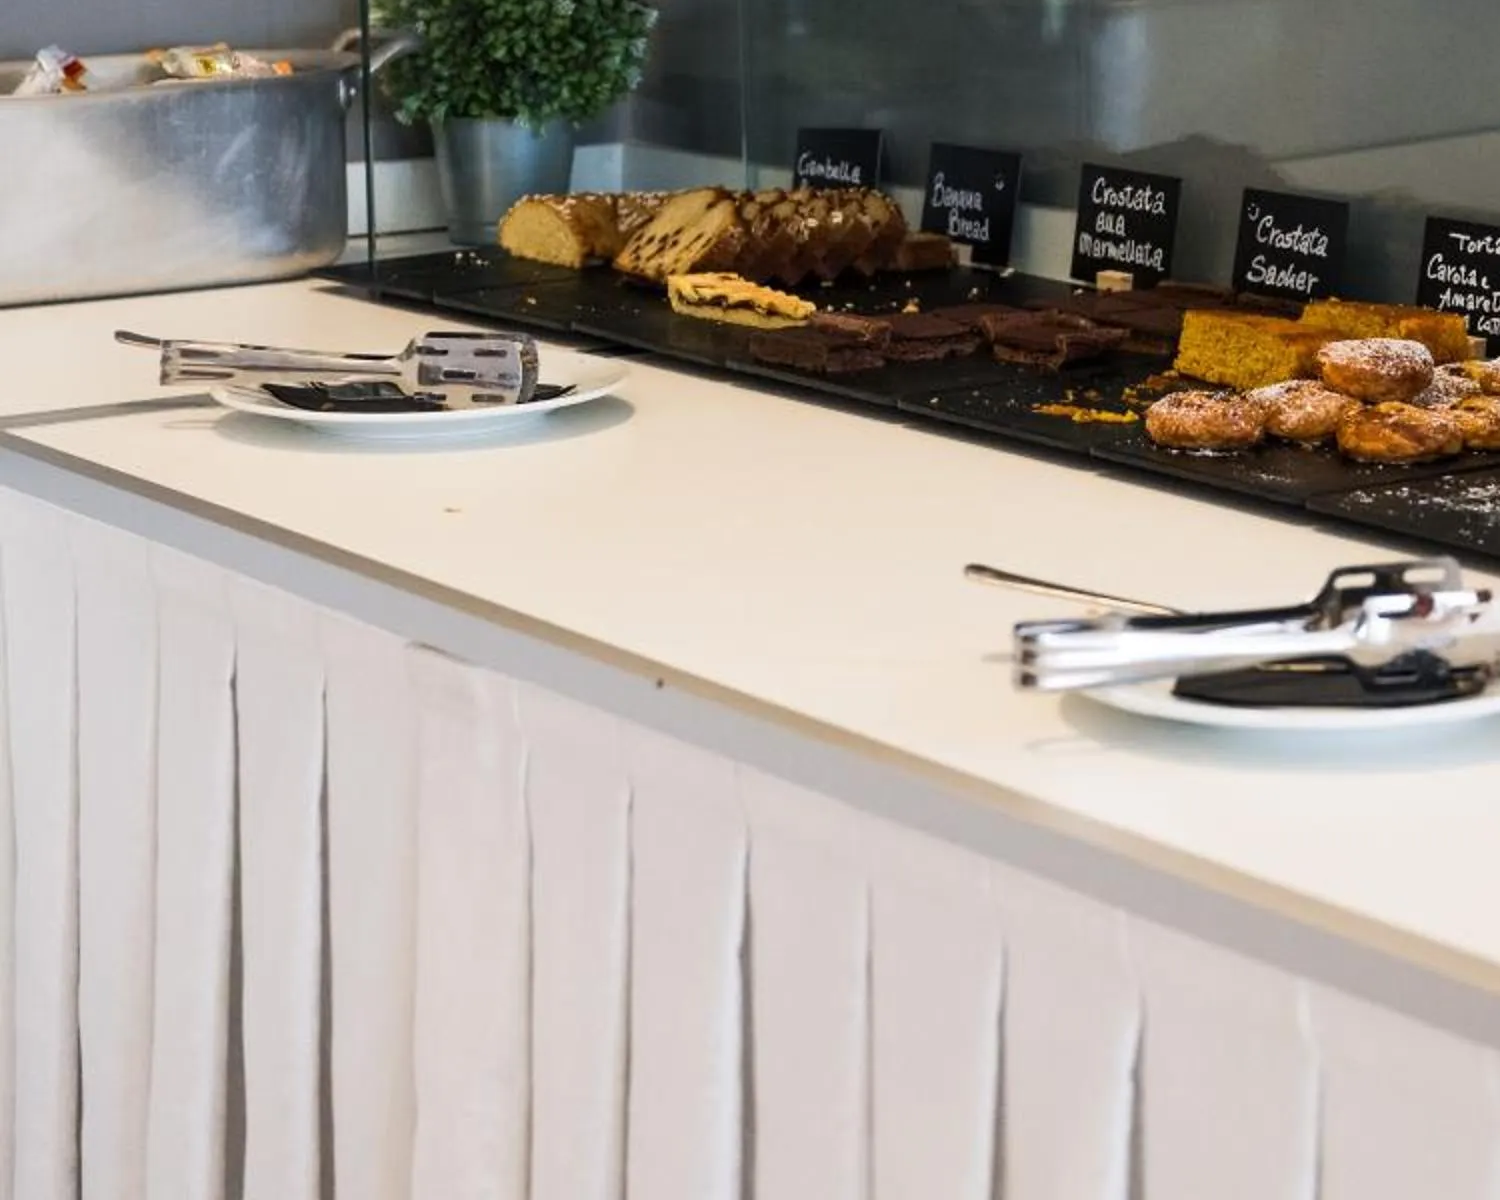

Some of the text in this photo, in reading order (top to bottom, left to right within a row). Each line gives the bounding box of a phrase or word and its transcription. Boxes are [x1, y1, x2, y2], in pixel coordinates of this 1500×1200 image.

[1092, 177, 1166, 215] Crostata
[949, 211, 989, 241] Bread
[1256, 215, 1329, 257] Crostata
[1246, 254, 1319, 294] Sacher
[1427, 253, 1478, 287] Carota
